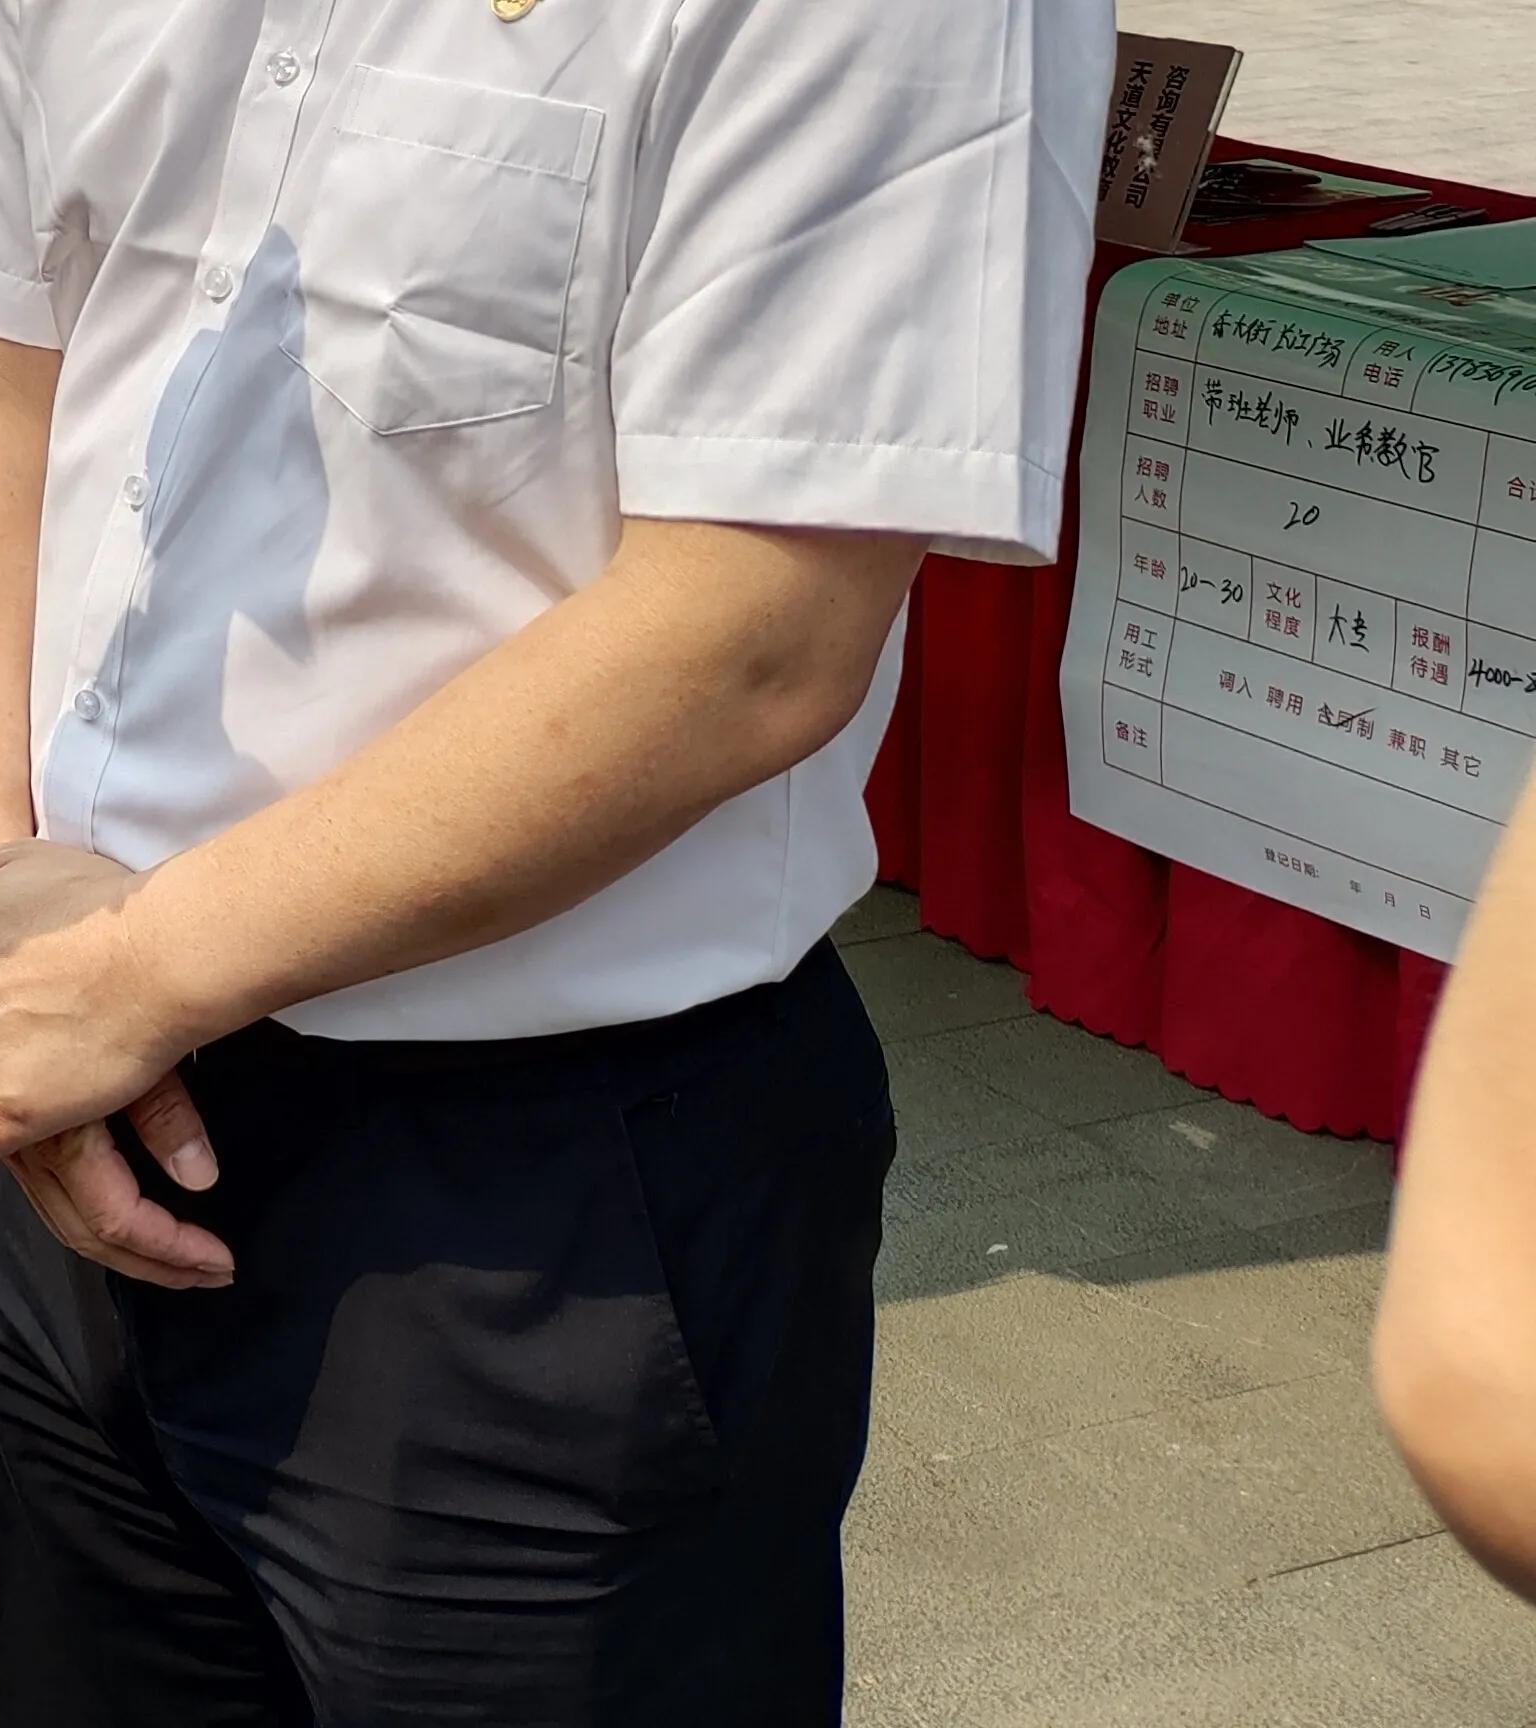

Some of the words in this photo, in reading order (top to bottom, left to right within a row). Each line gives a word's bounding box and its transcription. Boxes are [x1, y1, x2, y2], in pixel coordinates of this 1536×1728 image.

[1161, 293, 1200, 314] 单位
[1153, 318, 1188, 340] 地址
[1373, 340, 1417, 362] 用人
[1144, 372, 1180, 397] 招聘
[1363, 364, 1404, 388] 电话
[1143, 399, 1176, 423] 职业
[1137, 457, 1170, 482] 招聘
[1134, 484, 1169, 510] 人数
[1507, 476, 1536, 504] 合
[1283, 501, 1321, 530] 20
[1132, 552, 1169, 581] 年龄
[1266, 582, 1301, 608] 文化
[1124, 623, 1159, 652] 用工
[1265, 610, 1301, 638] 程度
[1328, 603, 1370, 653] 大专
[1411, 625, 1450, 656] 报酬
[1119, 649, 1154, 678] 形式
[1410, 656, 1449, 686] 待遇
[1114, 721, 1149, 749] 备注
[1219, 671, 1255, 703] 调入
[1268, 686, 1305, 717] 聘用
[1388, 729, 1428, 762] 兼职
[1440, 748, 1482, 778] 其它
[1349, 879, 1364, 896] 年
[1383, 892, 1397, 909] 月
[1419, 903, 1432, 920] 日
